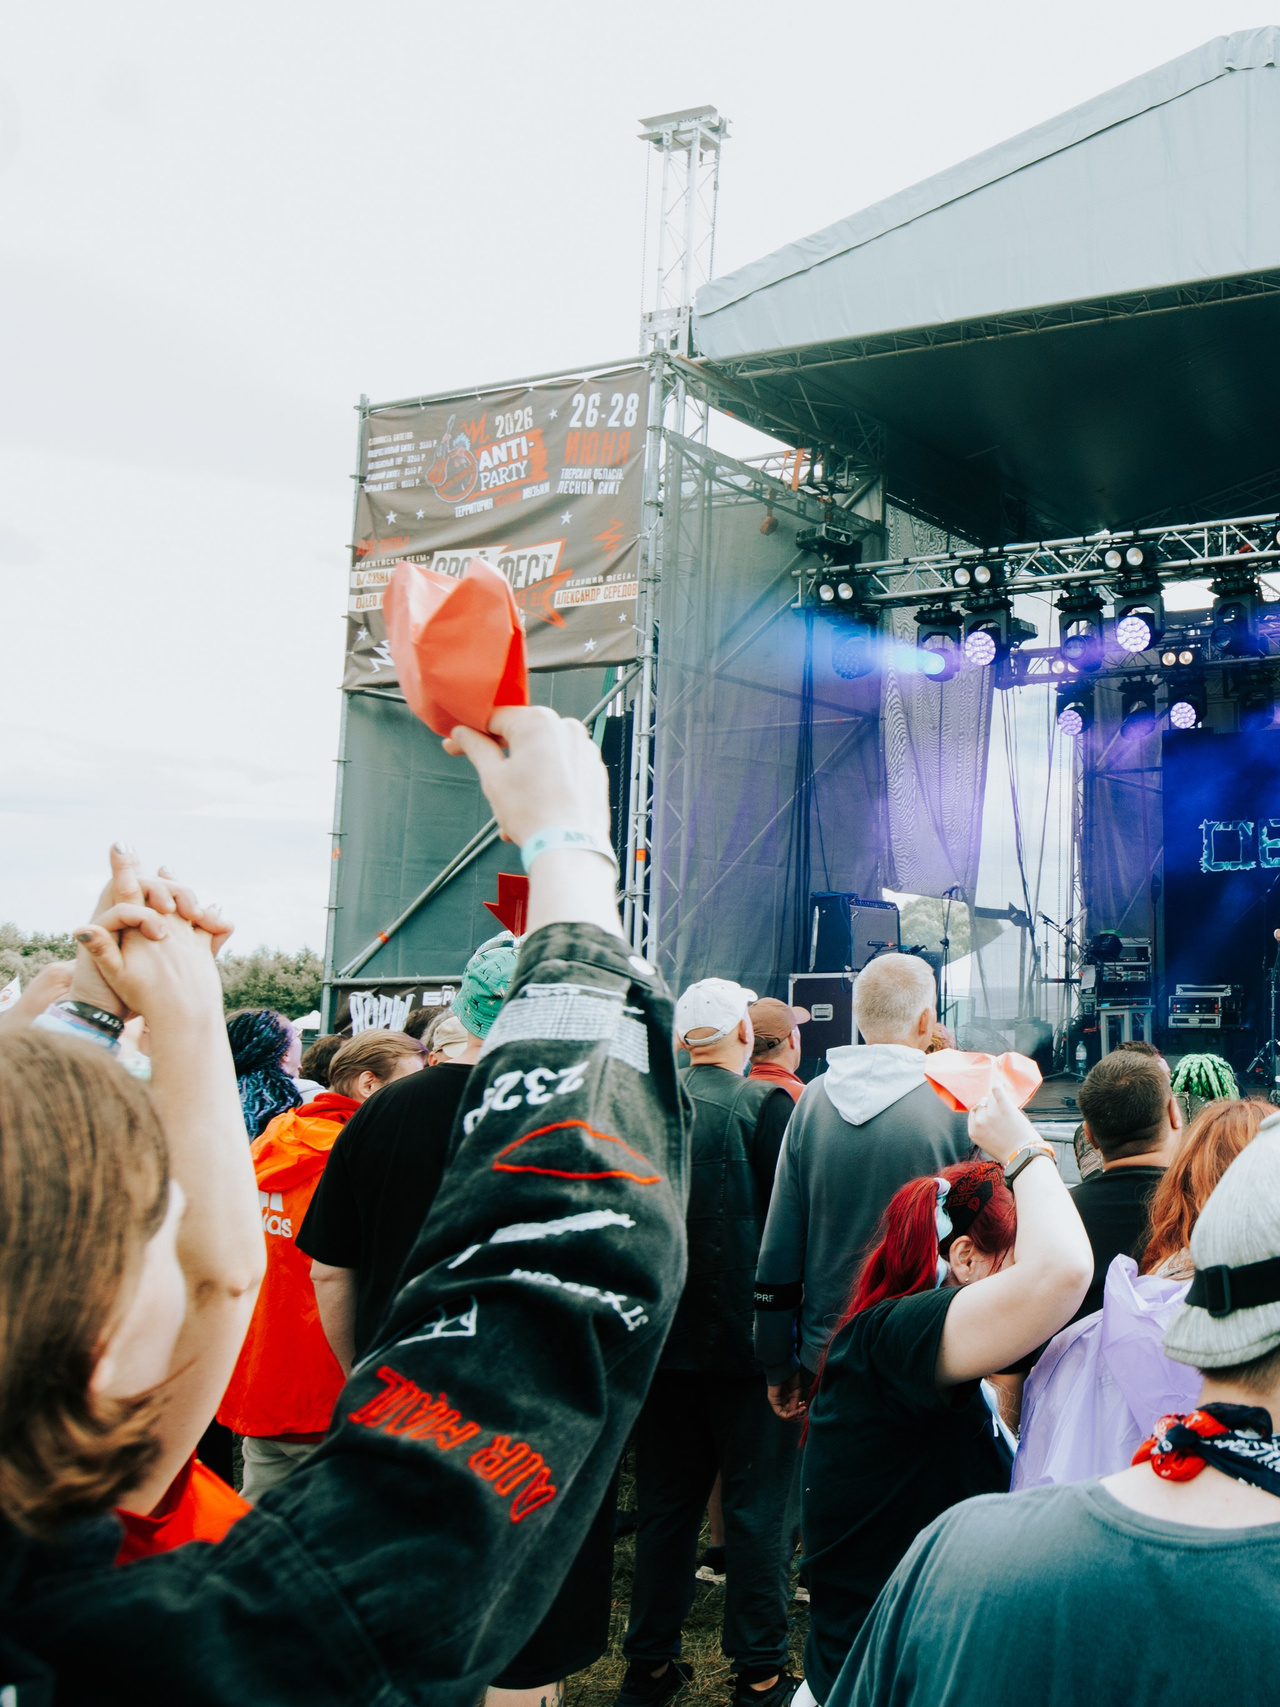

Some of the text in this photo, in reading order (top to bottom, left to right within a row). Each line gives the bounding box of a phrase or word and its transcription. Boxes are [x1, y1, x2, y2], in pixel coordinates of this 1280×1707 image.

[495, 406, 533, 438] 2026
[569, 392, 640, 428] 26-28
[479, 436, 535, 472] ANTI-
[564, 430, 631, 466] ИЮНЯ
[480, 460, 528, 491] PARTY
[556, 479, 621, 495] ЛЕСНОЙ СКИТ
[556, 589, 601, 605] АЛЕКСАНДР
[468, 1435, 557, 1523] AIR
